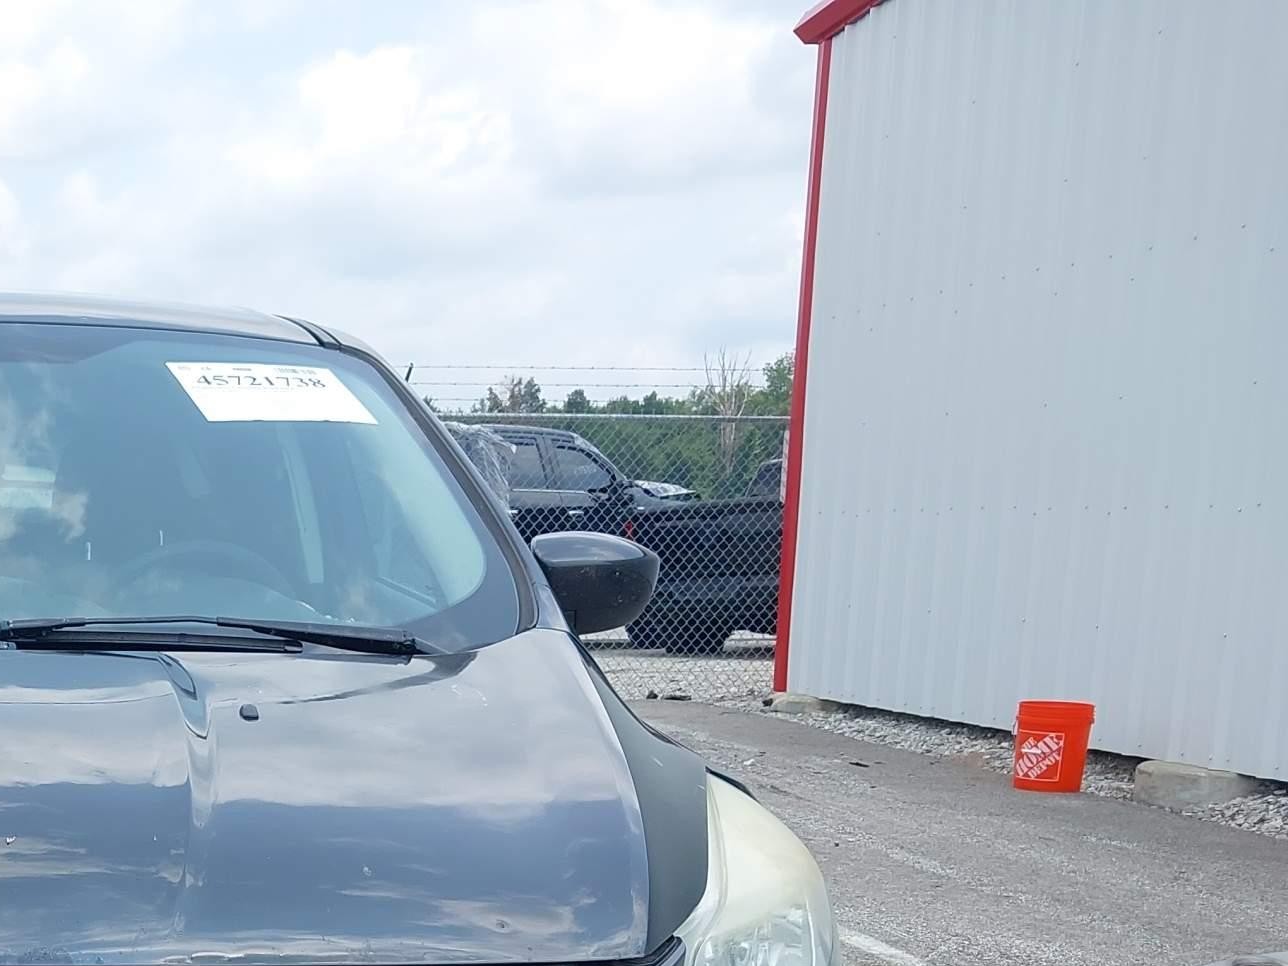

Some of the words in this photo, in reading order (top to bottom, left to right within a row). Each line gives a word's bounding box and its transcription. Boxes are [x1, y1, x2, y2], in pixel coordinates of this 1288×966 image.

[196, 374, 326, 389] 45721738
[1016, 734, 1063, 777] HOME
[1027, 750, 1061, 778] DEPOT
